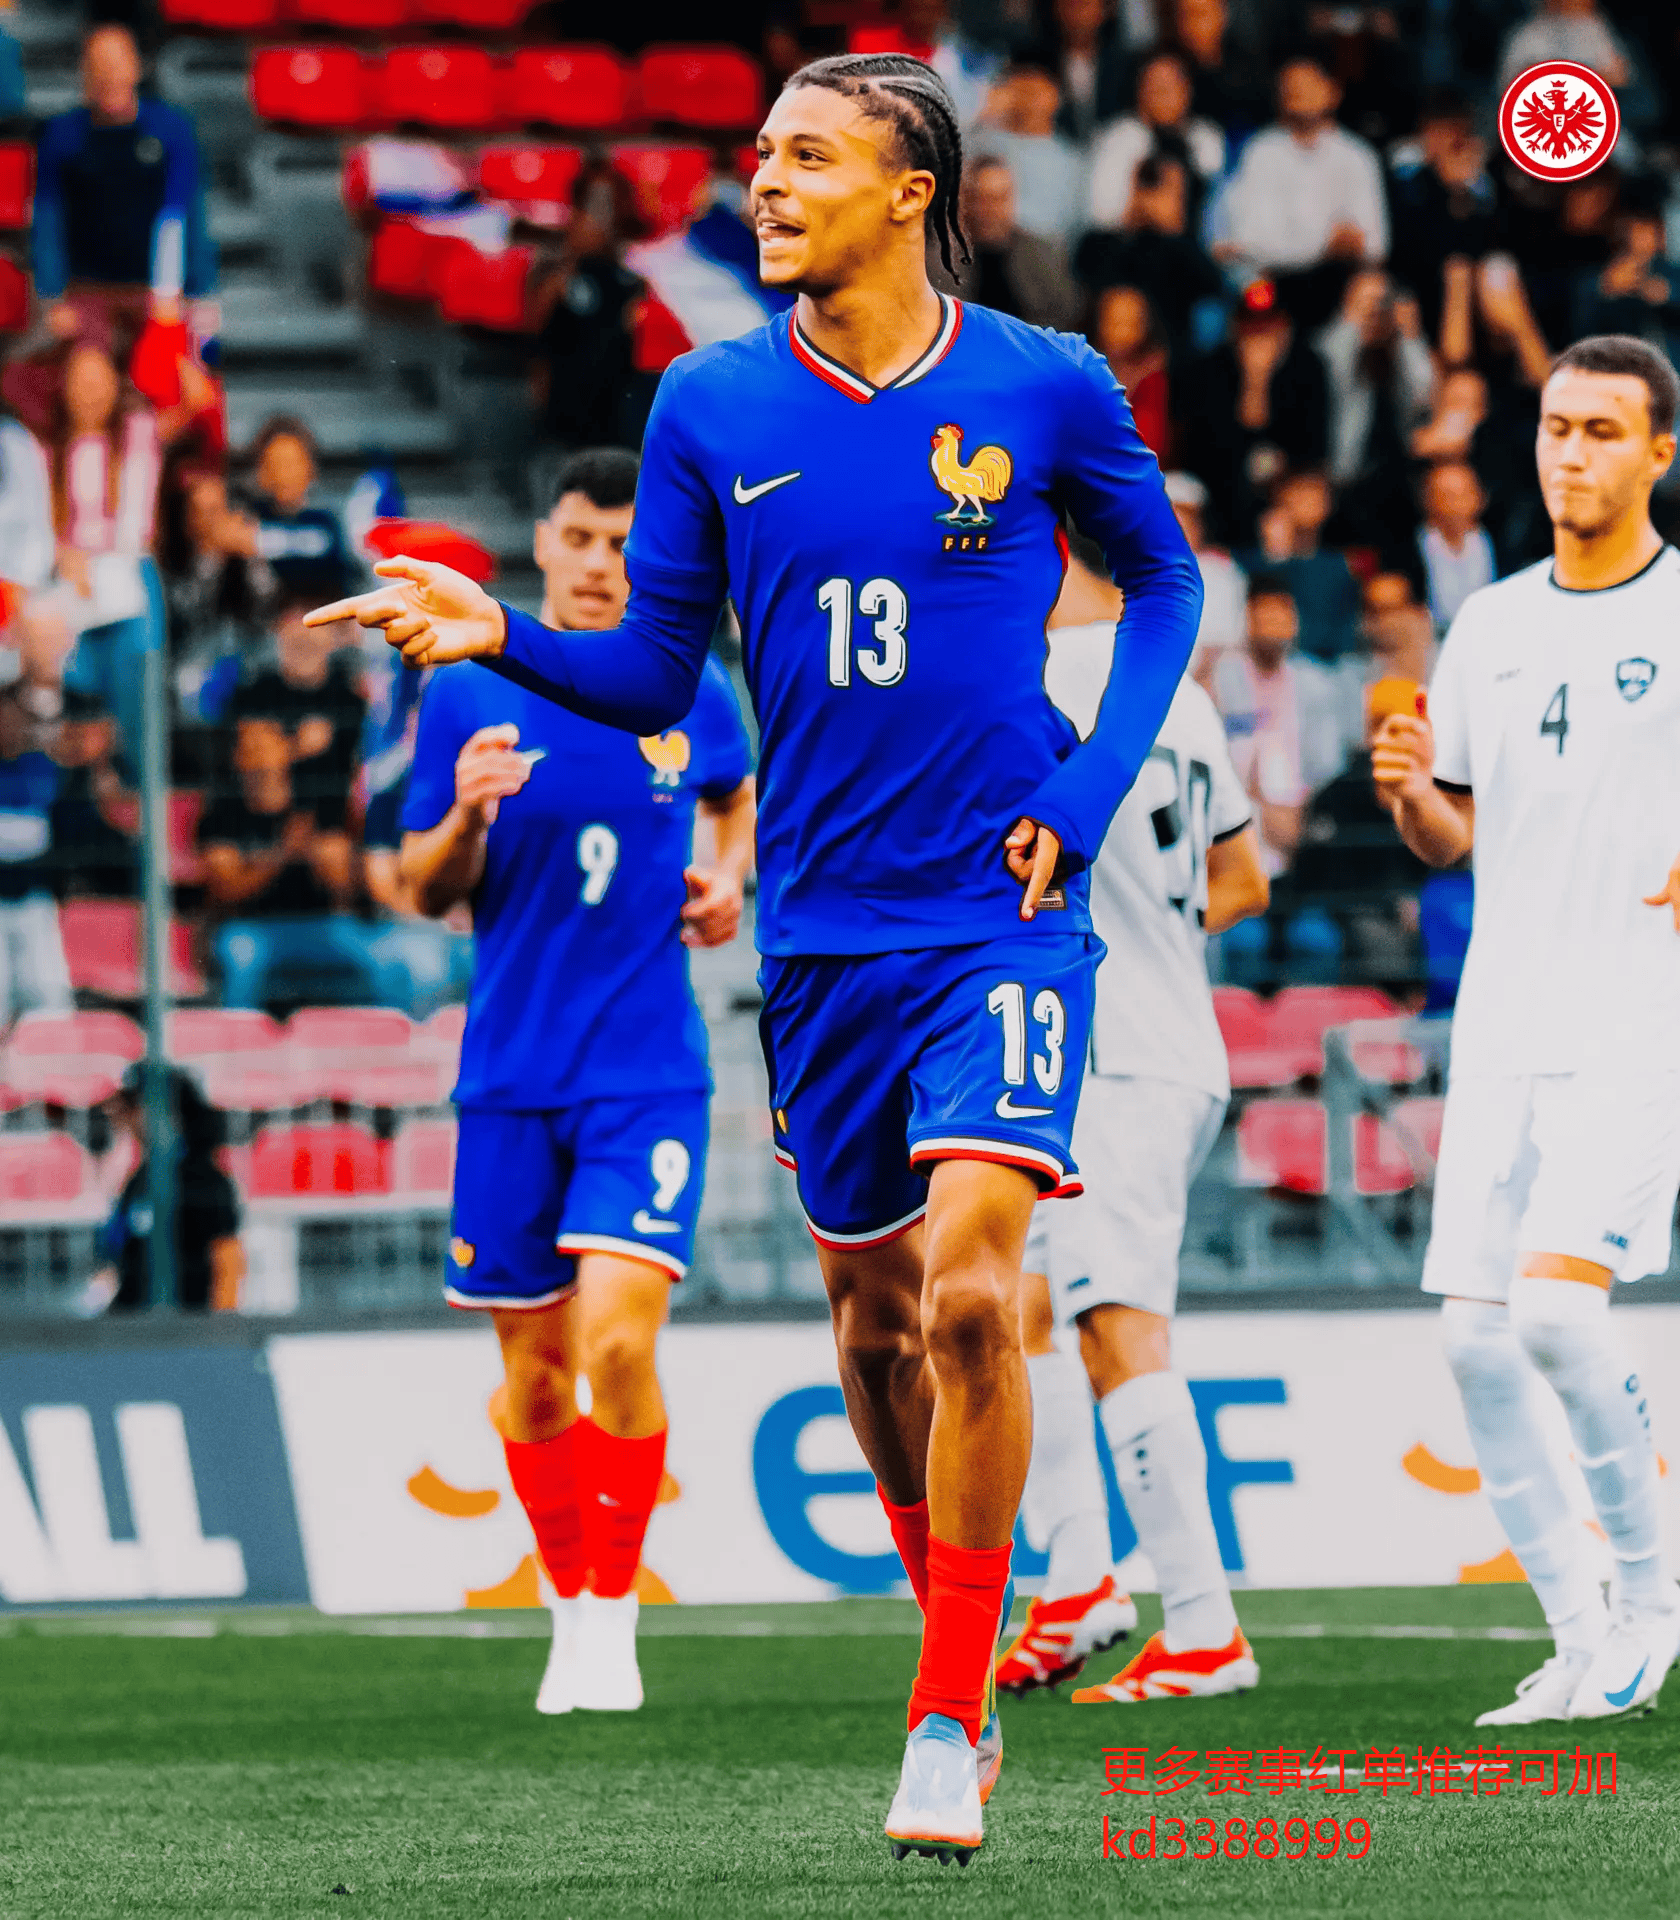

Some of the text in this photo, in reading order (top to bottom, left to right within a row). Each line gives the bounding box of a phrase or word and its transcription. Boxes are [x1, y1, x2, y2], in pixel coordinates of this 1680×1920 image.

[817, 577, 908, 688] 13
[1539, 682, 1569, 756] 4
[577, 823, 619, 906] 9
[987, 982, 1066, 1096] 13
[650, 1138, 691, 1214] 9
